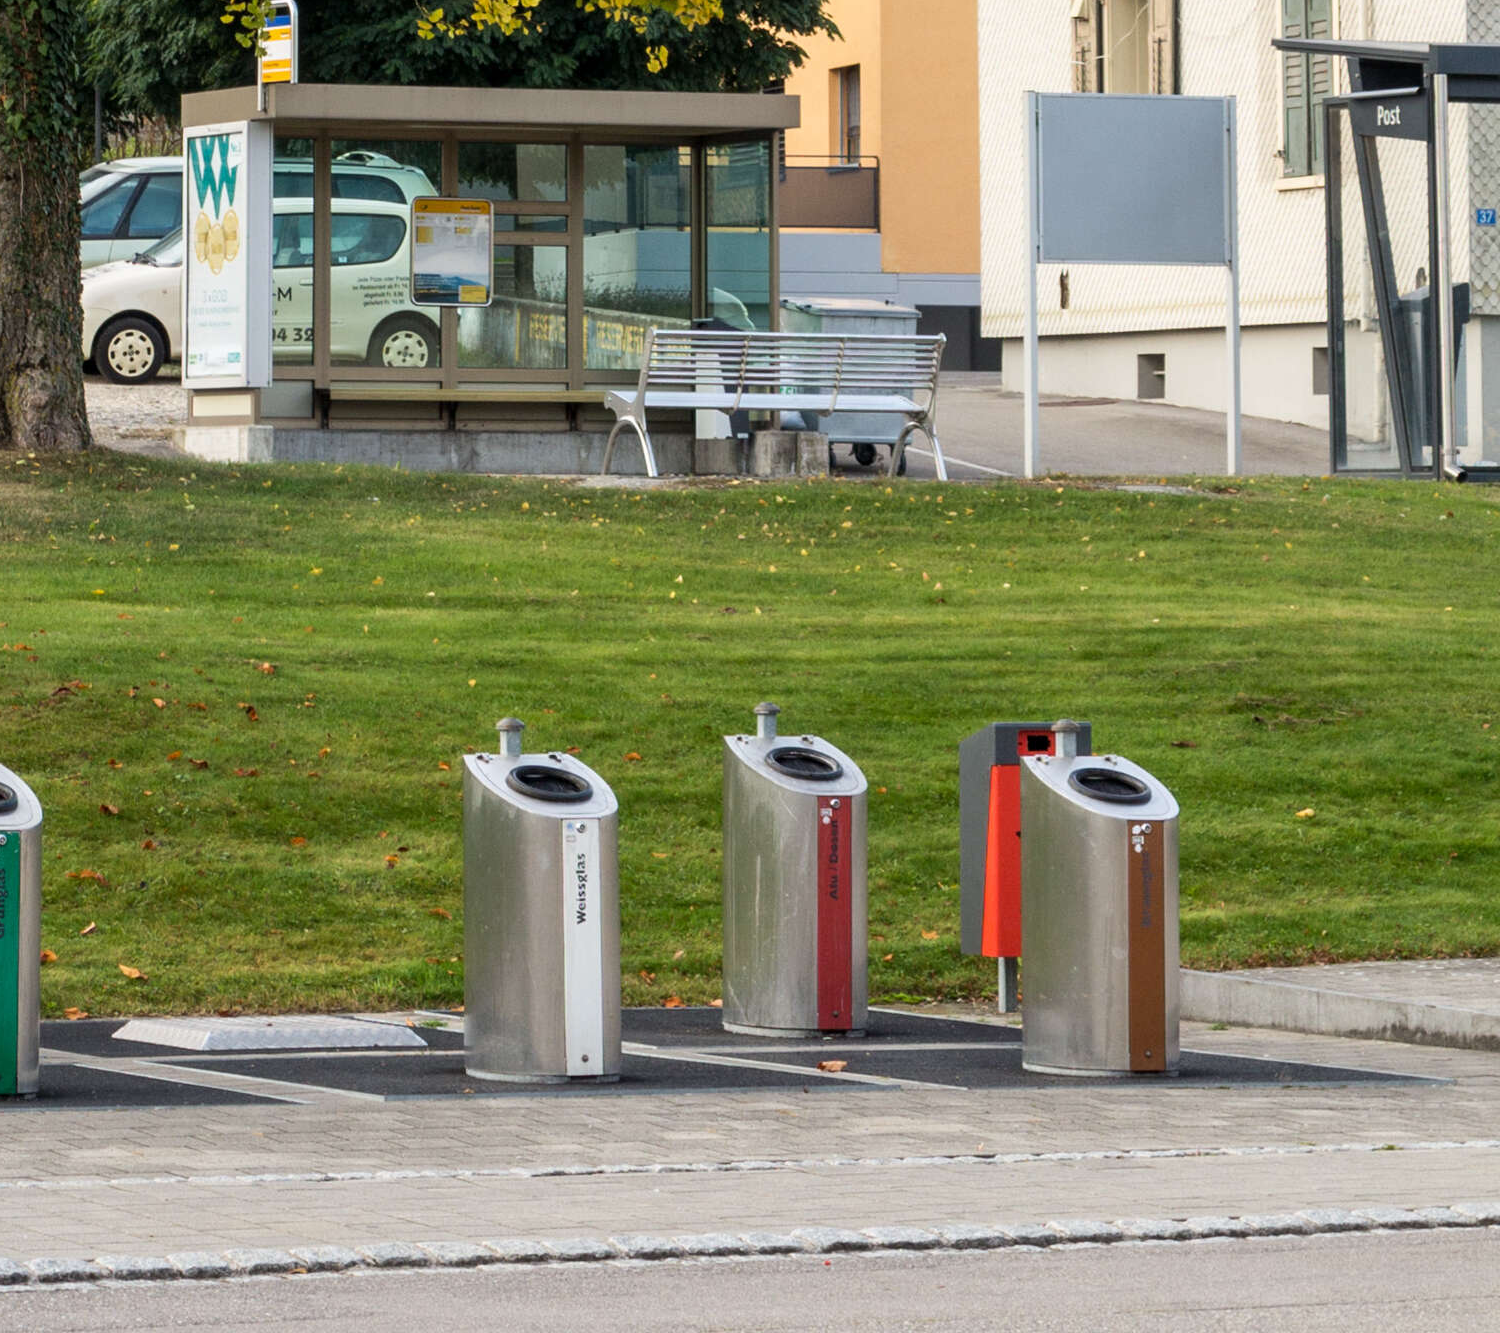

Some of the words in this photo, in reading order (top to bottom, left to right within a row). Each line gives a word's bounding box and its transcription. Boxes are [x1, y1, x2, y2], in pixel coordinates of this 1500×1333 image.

[1377, 106, 1401, 125] Post
[1480, 210, 1493, 223] 37
[829, 820, 838, 864] Dosen
[576, 853, 588, 925] Weissglas
[829, 875, 839, 901] Alu
